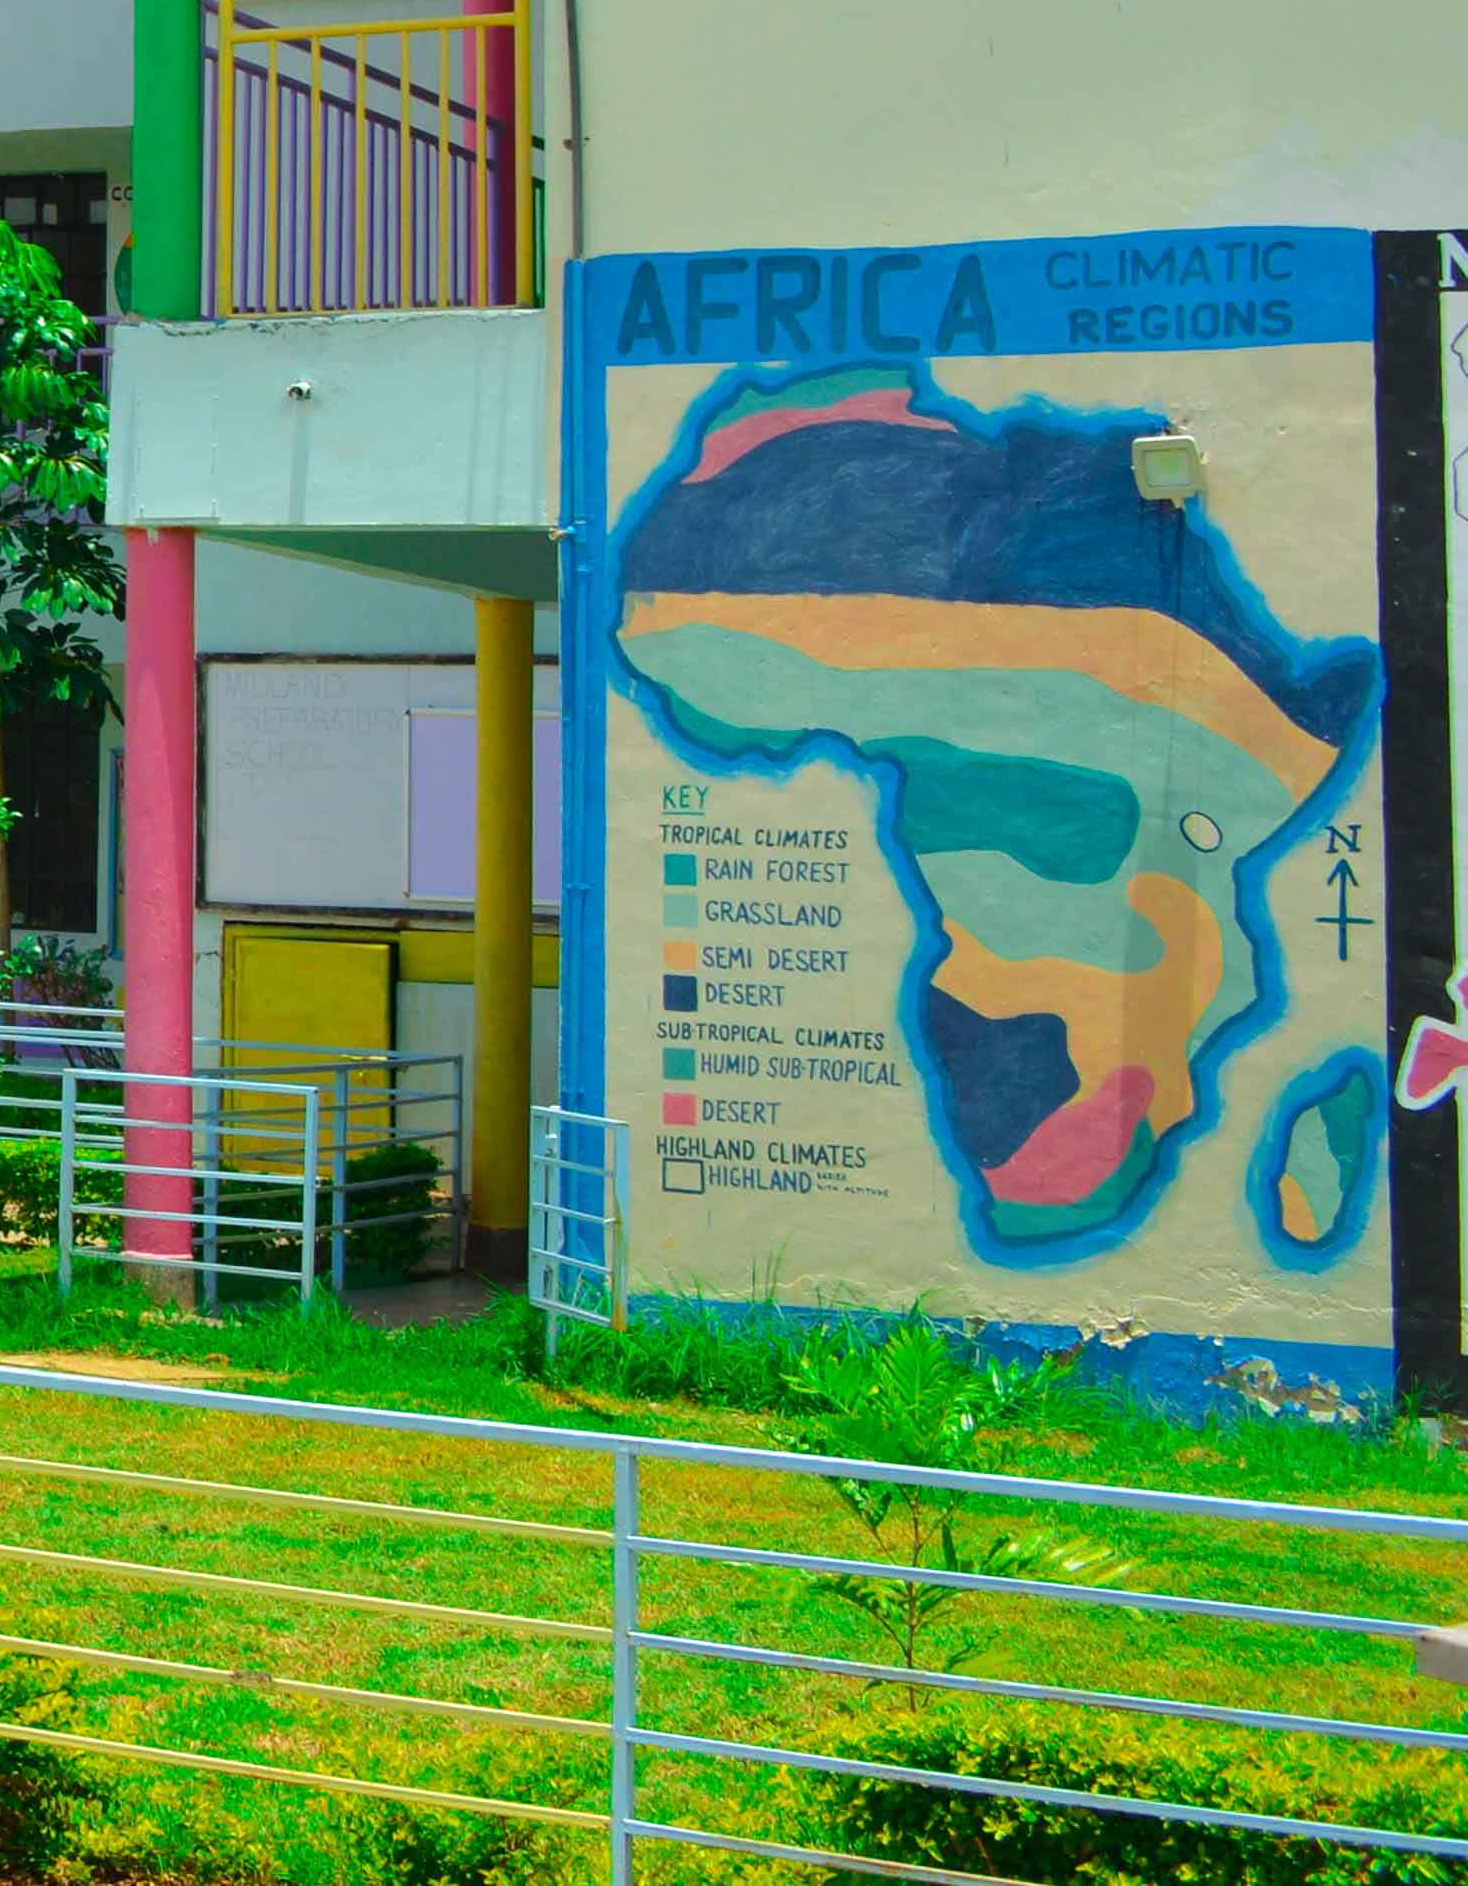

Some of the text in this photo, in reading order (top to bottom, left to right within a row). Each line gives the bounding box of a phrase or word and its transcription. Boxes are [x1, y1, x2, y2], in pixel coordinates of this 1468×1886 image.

[616, 240, 1296, 355] AFRICA CLIMATIC
[1069, 299, 1296, 347] REGIONS
[662, 785, 711, 809] KEY
[659, 824, 849, 849] TROPICAL CLIMATES
[1325, 823, 1361, 853] N
[705, 858, 850, 883] RAIN FOREST
[704, 900, 842, 928] GRASSLAND
[701, 946, 850, 973] SEMI DESERT
[705, 982, 786, 1007] DESERT
[795, 1027, 885, 1051] CLIMATES
[700, 1053, 759, 1076] HUMID
[702, 1099, 781, 1125] DESERT
[656, 1135, 867, 1169] HIGHLAND CLIMATES
[708, 1165, 813, 1195] HIGHLAND
